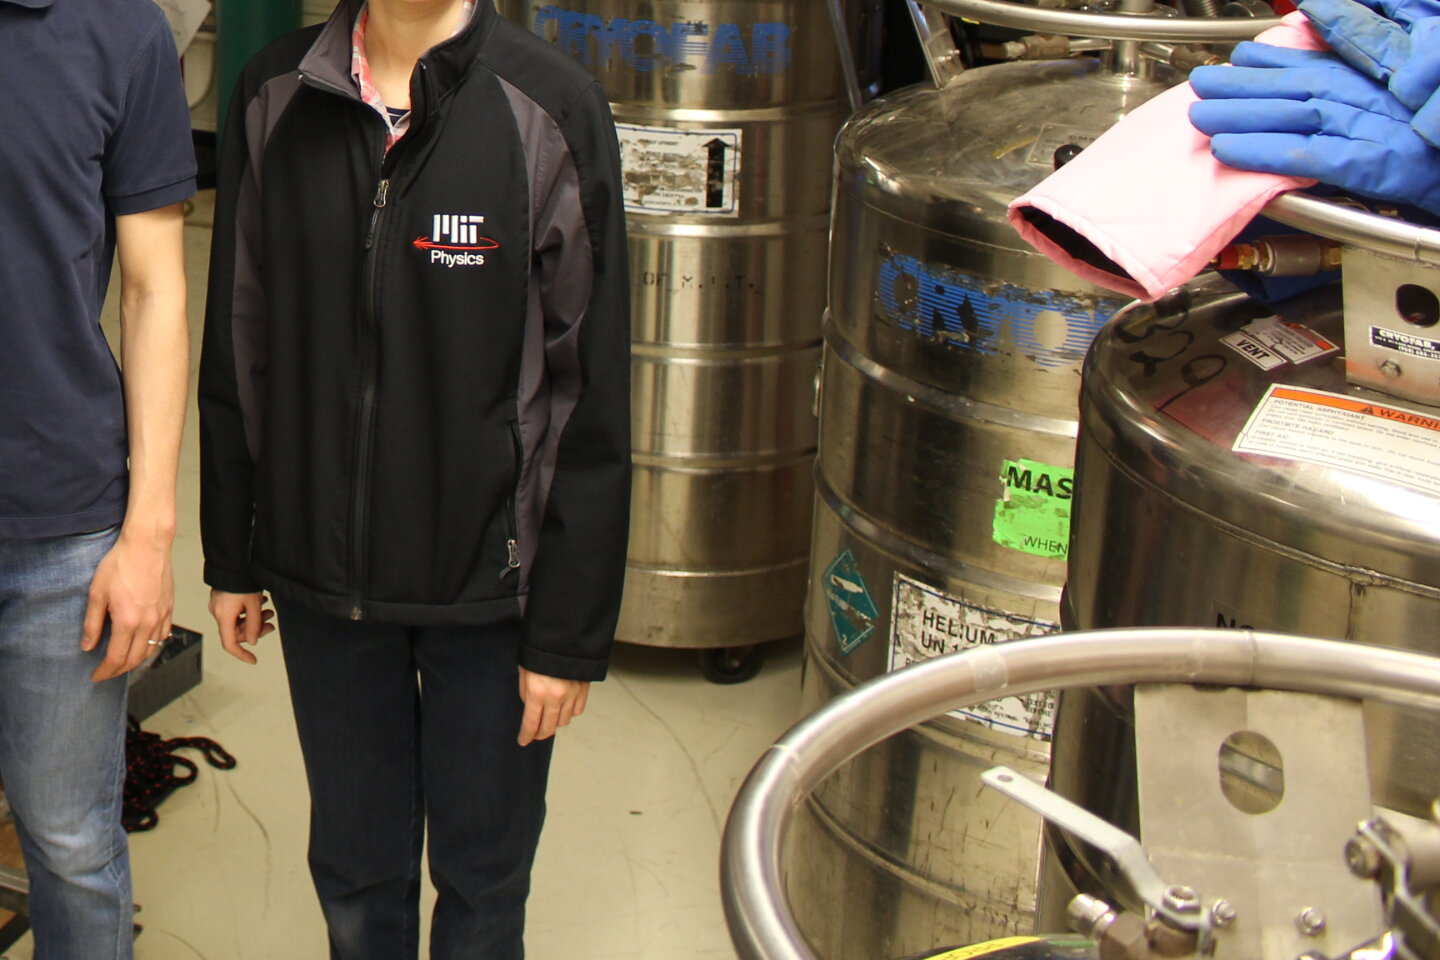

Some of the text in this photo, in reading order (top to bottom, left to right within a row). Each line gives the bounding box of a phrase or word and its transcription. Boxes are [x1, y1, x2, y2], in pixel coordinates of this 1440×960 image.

[431, 250, 484, 268] Physics
[1236, 339, 1270, 360] VENT
[1273, 399, 1314, 410] POTENTIAL
[1317, 407, 1366, 421] ASPHYXIANT
[1262, 418, 1306, 430] FROSTBITE
[1307, 425, 1334, 435] HAZARD
[1024, 536, 1067, 554] WHEN
[923, 610, 995, 644] HELIUM
[841, 634, 848, 645] 2
[921, 631, 945, 654] UN
